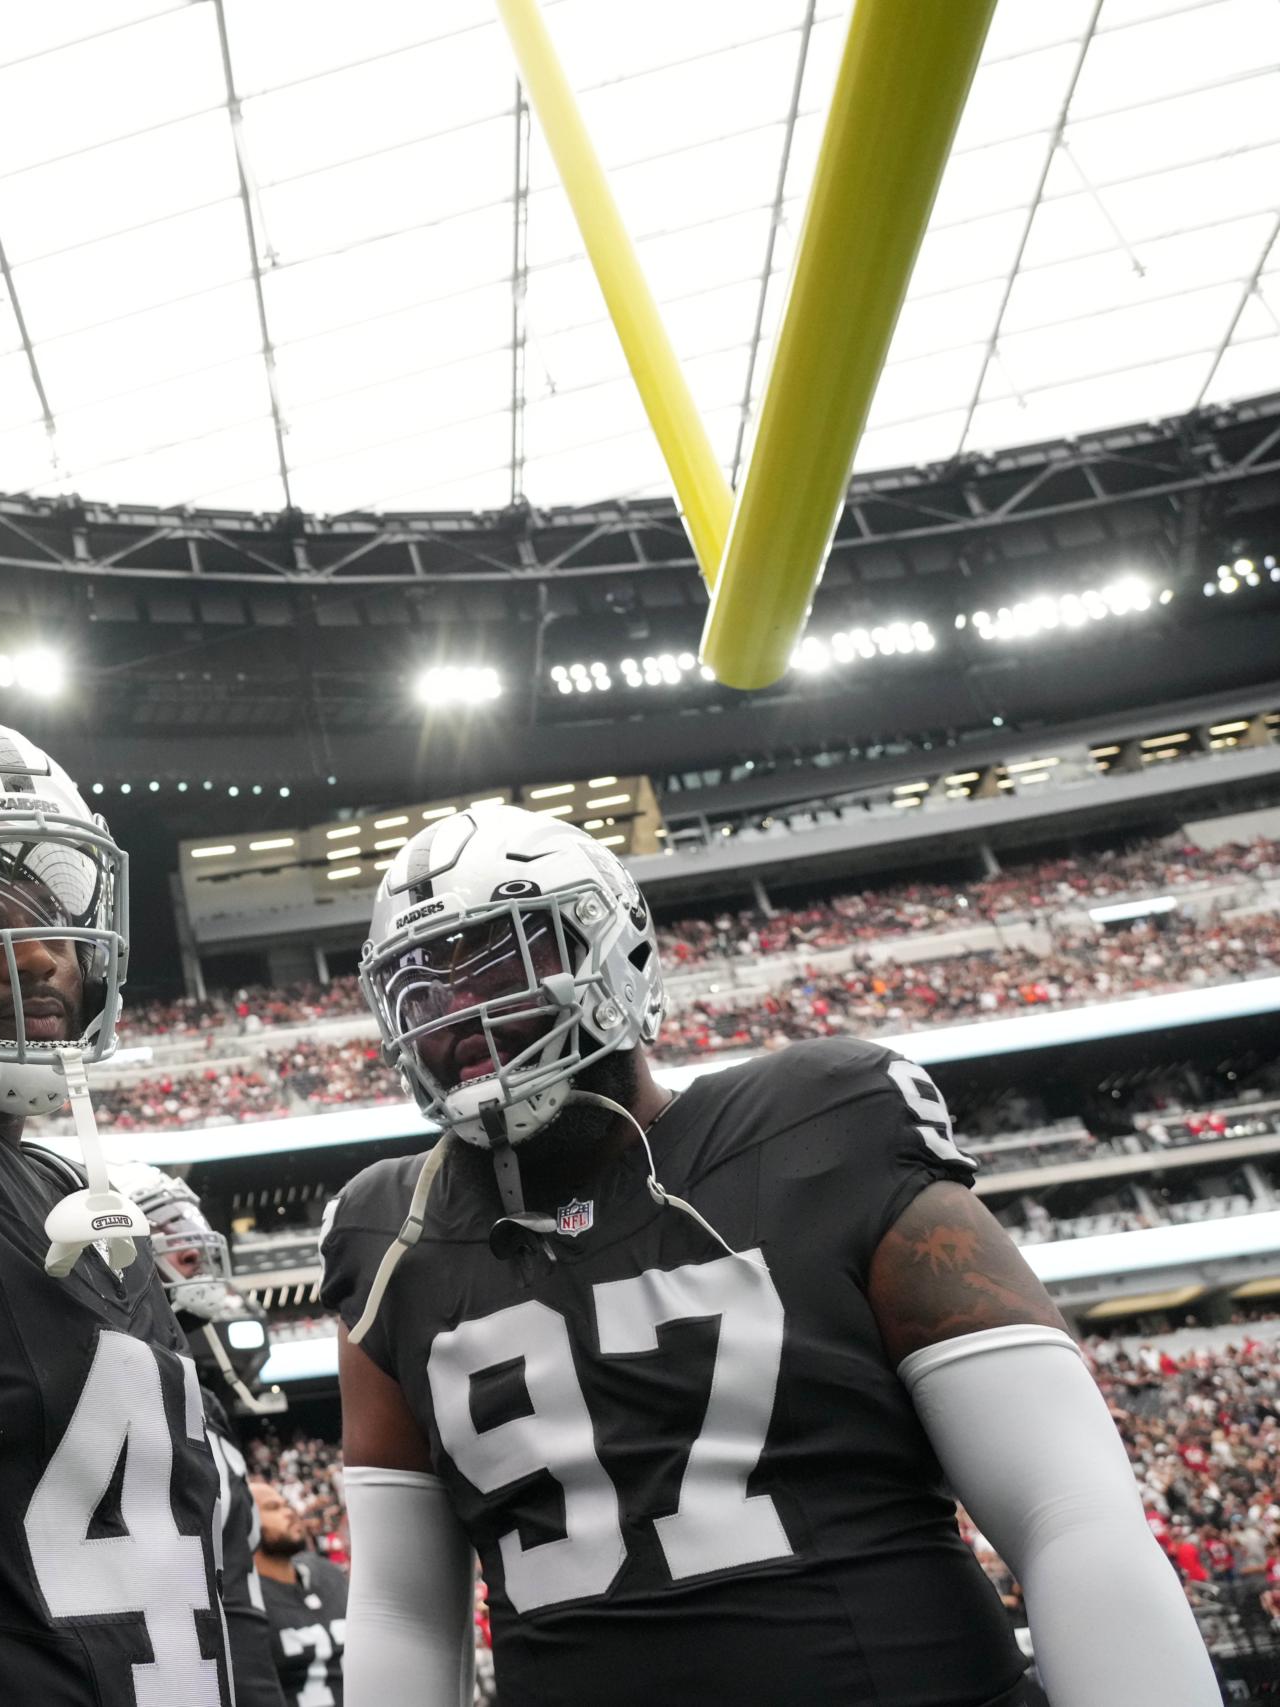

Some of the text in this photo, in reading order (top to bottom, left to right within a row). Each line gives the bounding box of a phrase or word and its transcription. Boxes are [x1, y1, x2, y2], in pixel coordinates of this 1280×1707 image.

[395, 900, 445, 930] RAIDERS
[95, 1217, 130, 1228] BATTLE
[562, 1213, 587, 1229] NFL
[426, 1248, 794, 1614] 97
[23, 1330, 236, 1707] 4
